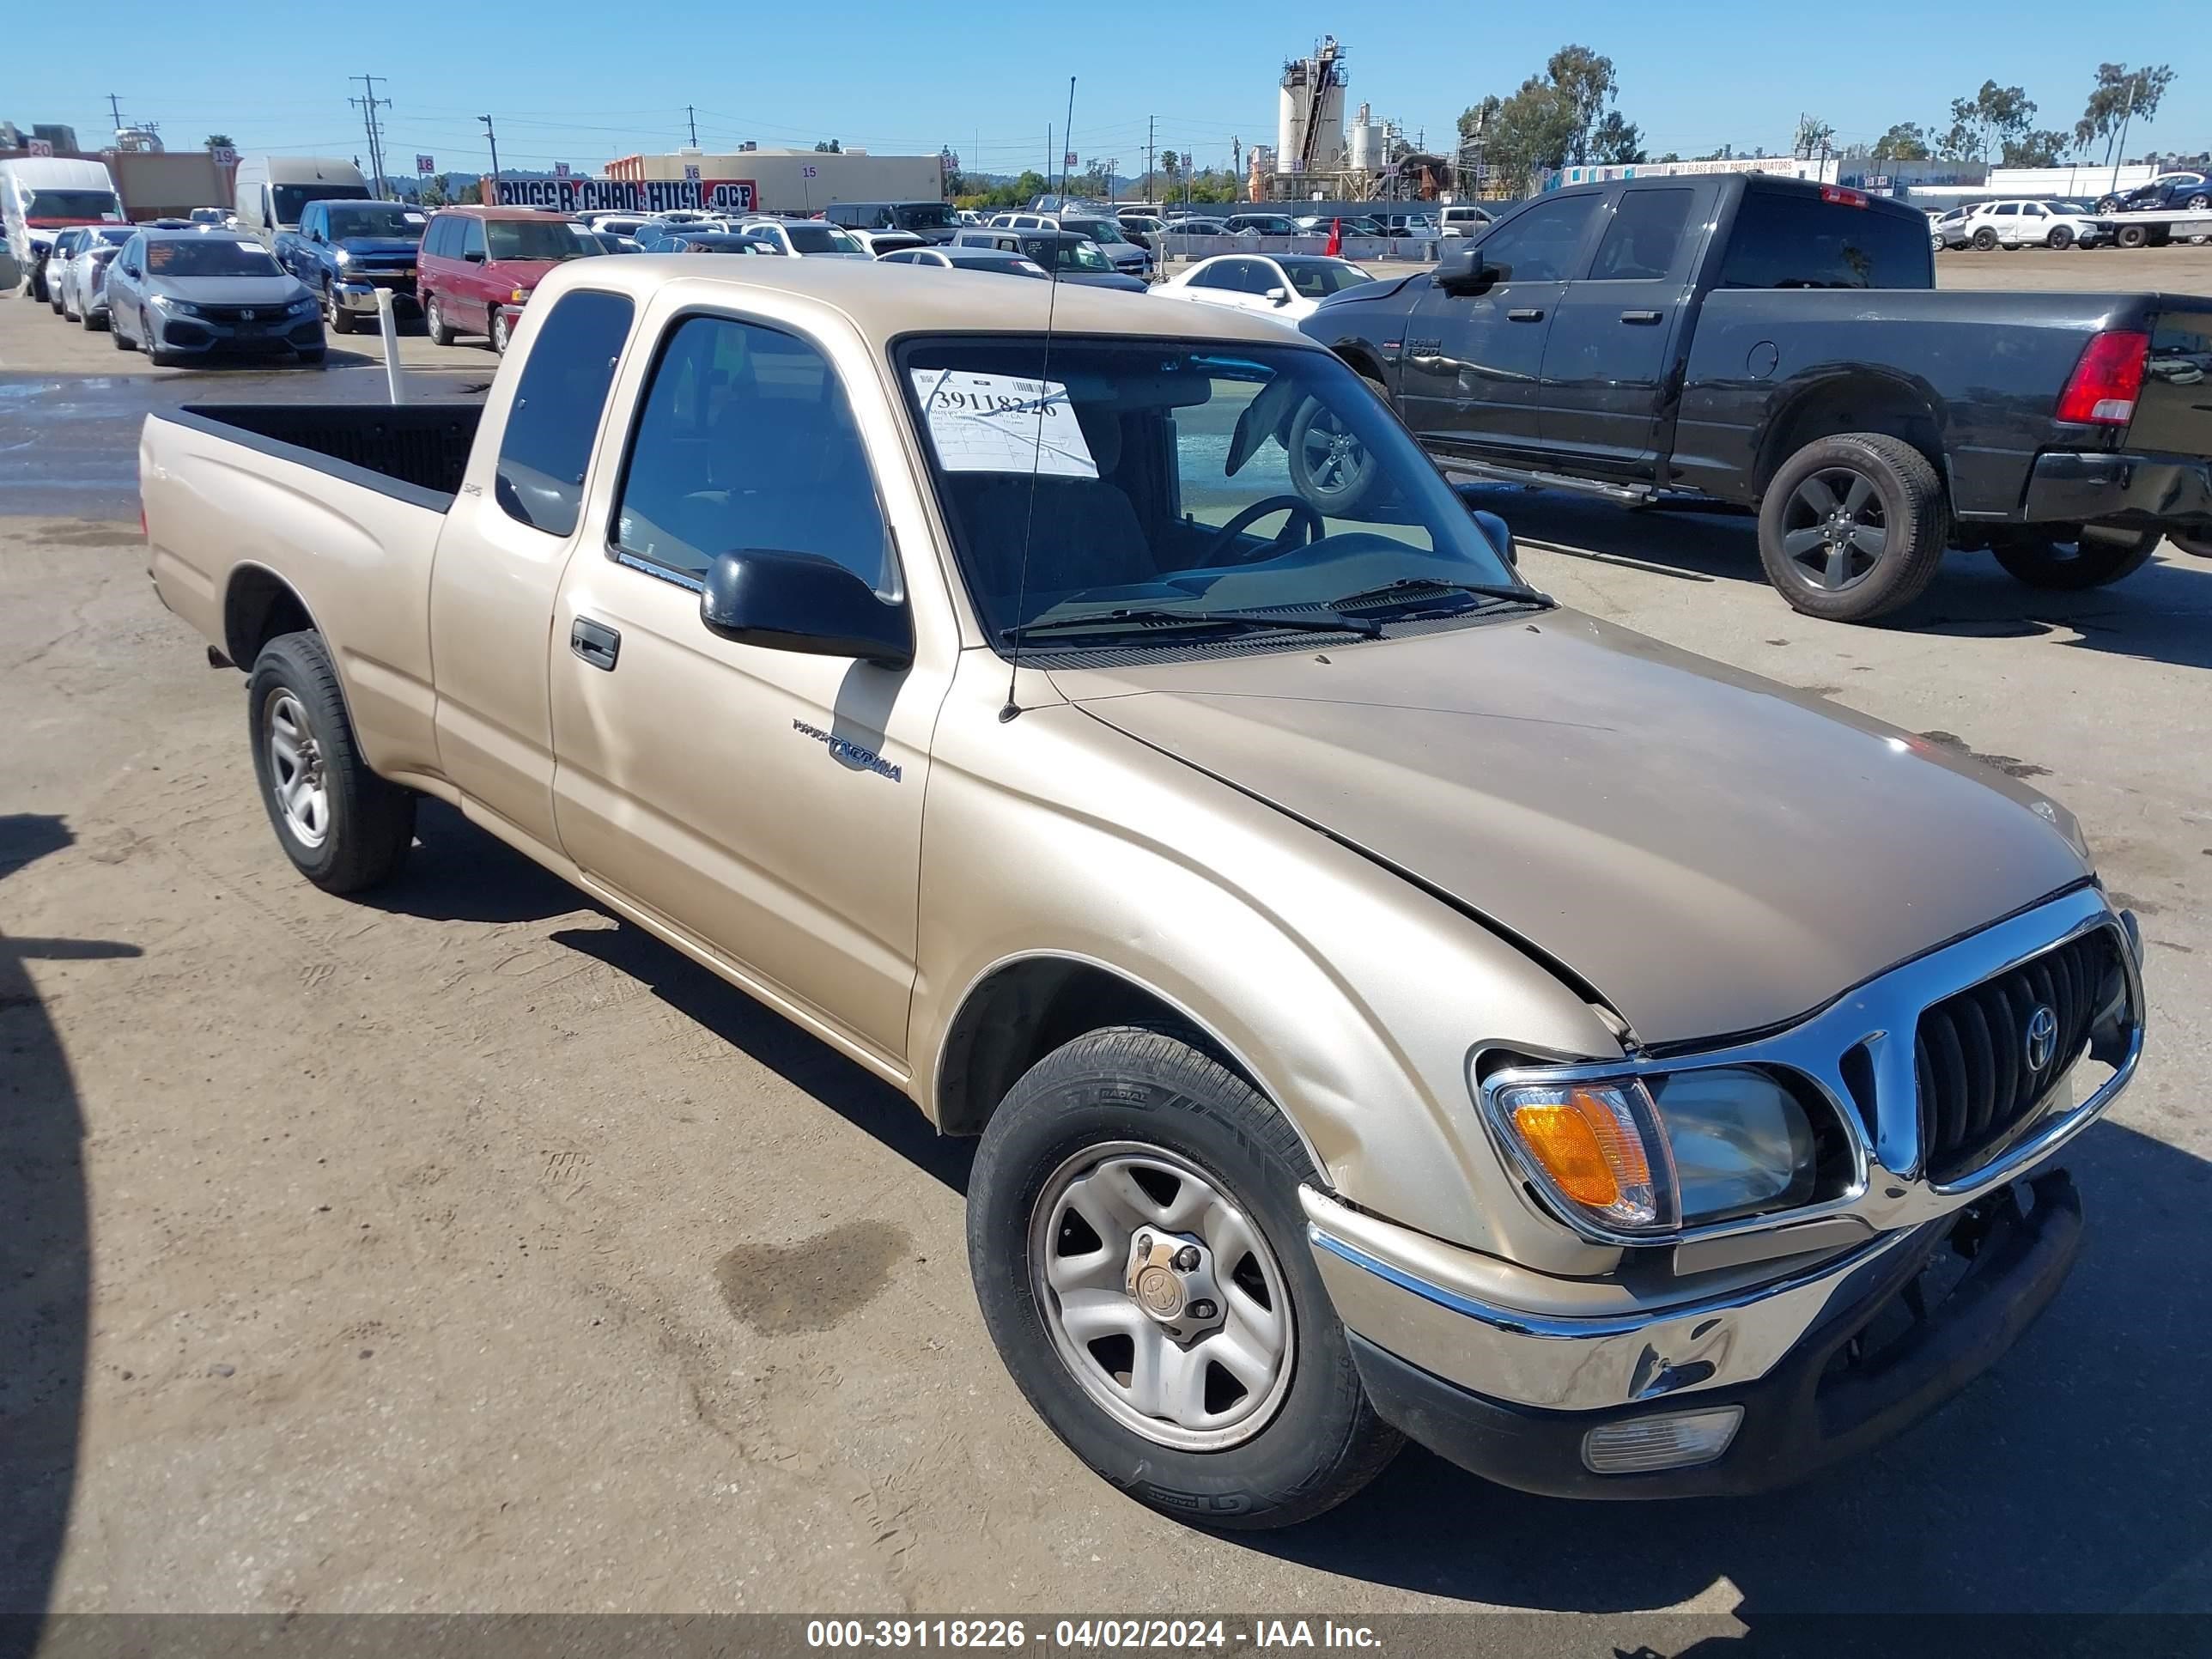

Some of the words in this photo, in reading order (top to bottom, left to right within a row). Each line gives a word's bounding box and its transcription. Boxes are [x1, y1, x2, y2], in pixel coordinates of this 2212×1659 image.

[30, 142, 51, 158] 20
[215, 150, 233, 163] 19
[1066, 155, 1078, 164] 13
[1182, 156, 1192, 166] 12
[417, 158, 434, 170] 18
[1387, 165, 1398, 174] 10
[556, 165, 569, 177] 17
[687, 167, 701, 179] 16
[803, 167, 817, 178] 15
[1543, 168, 1549, 179] 8
[937, 391, 1057, 417] 39118226
[828, 736, 902, 783] TACOMA
